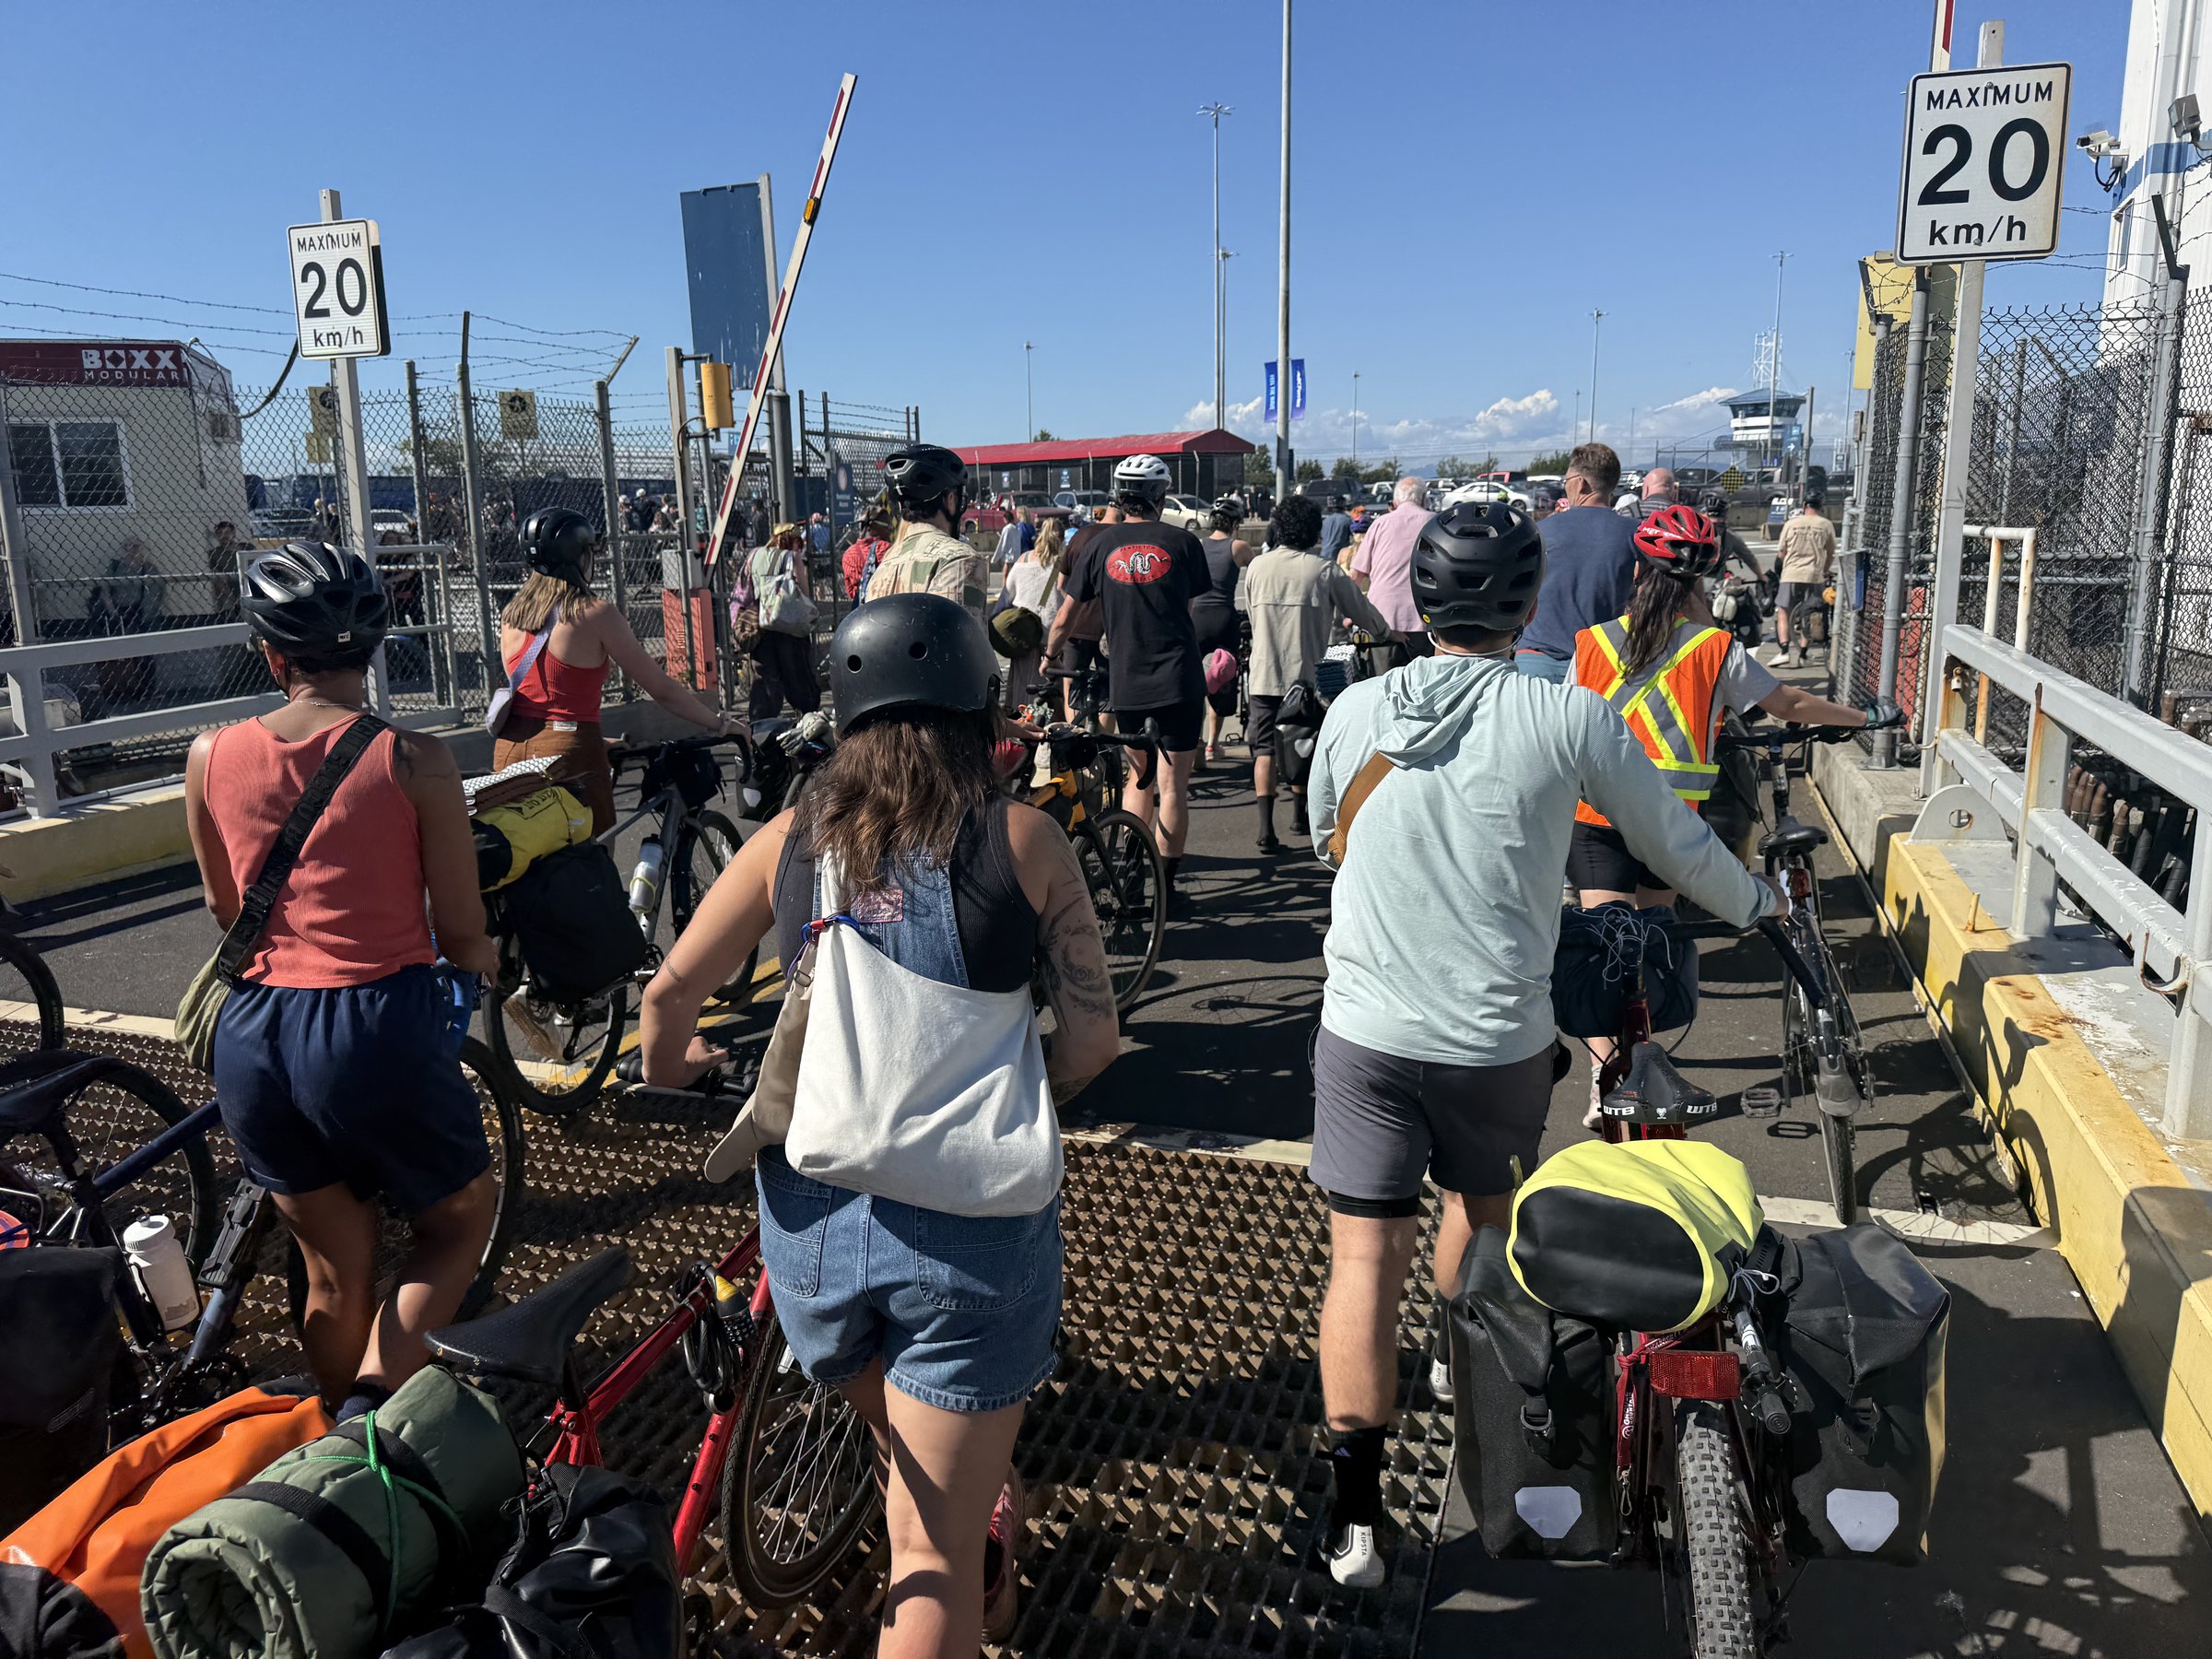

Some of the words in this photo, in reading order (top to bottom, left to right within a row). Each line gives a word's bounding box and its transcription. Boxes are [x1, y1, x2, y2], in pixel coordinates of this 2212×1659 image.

[1926, 81, 2053, 111] MAXIMUM
[1917, 117, 2050, 206] 20
[1929, 215, 2027, 246] km/h
[297, 232, 361, 252] MAXIMUM
[301, 258, 367, 319] 20
[313, 326, 364, 347] km/h
[81, 349, 178, 370] BOXX
[85, 371, 179, 380] MODULAR
[1604, 1105, 1635, 1116] WTB
[1687, 1101, 1717, 1114] WTB
